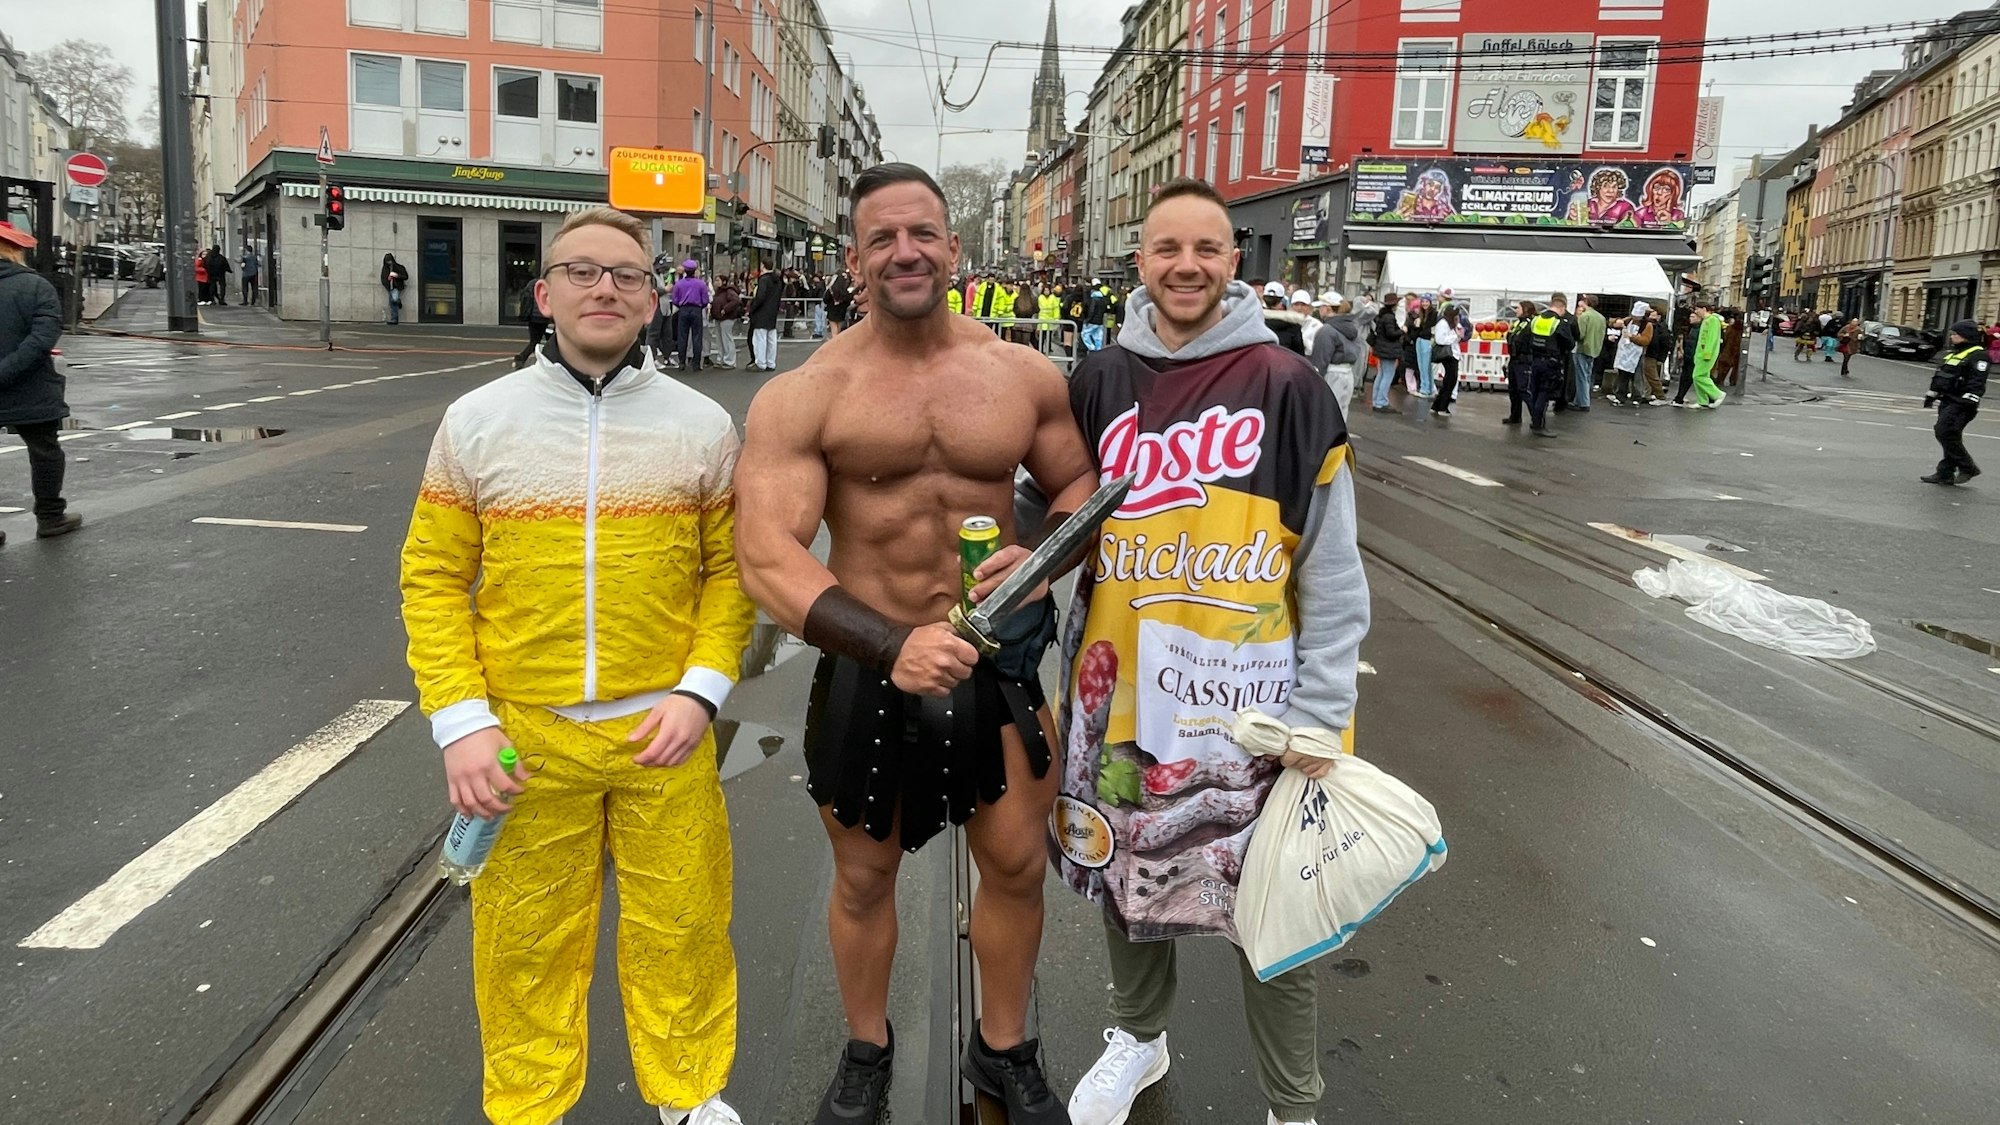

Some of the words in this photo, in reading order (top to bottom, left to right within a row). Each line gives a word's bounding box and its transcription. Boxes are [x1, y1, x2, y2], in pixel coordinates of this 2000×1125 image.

[616, 151, 665, 161] ZÜLPICHER
[631, 161, 685, 174] ZUGANG
[1462, 184, 1553, 203] KLIMAKTERIUM
[1461, 202, 1507, 211] SCHLÄGT
[1510, 203, 1553, 212] ZURÜCK
[1098, 404, 1262, 494] Aoste
[1095, 530, 1286, 591] Stickado
[1157, 666, 1290, 712] CLASSIQUE
[1178, 727, 1237, 745] Salami-St
[1341, 831, 1365, 852] alle.
